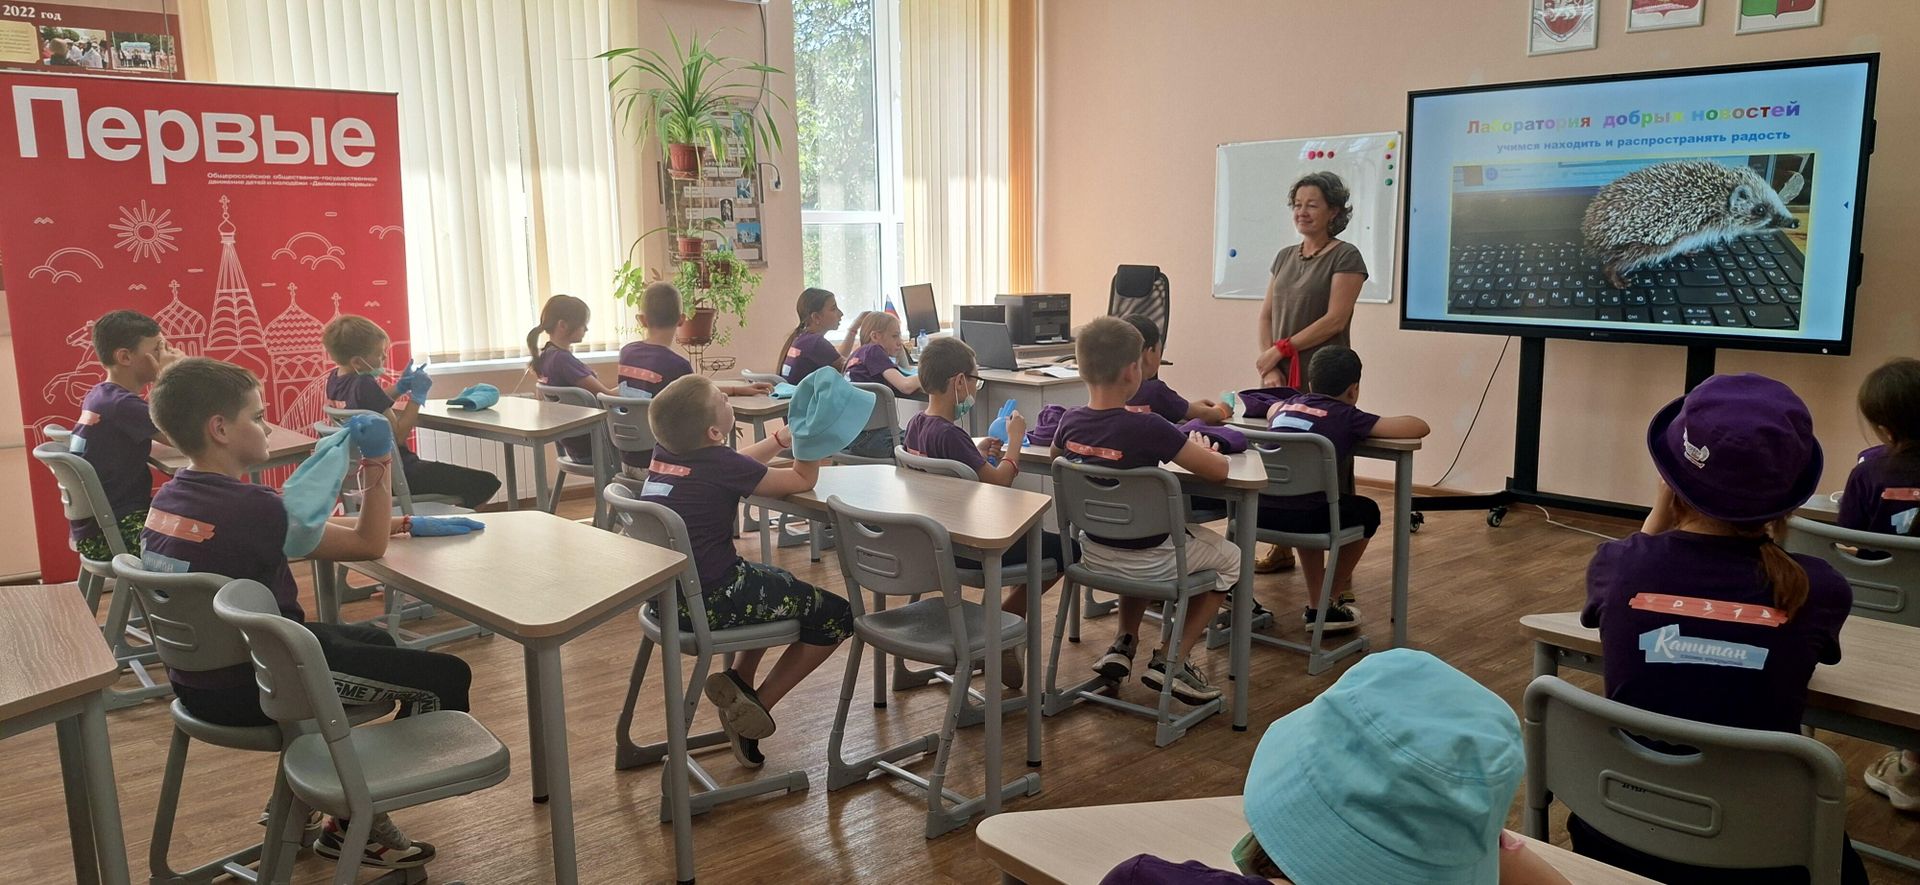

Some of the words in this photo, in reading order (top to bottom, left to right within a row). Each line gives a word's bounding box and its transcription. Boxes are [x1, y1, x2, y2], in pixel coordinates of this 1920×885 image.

[2, 4, 36, 18] 2022
[41, 11, 62, 21] год
[1467, 116, 1591, 134] Лаборатория
[1603, 109, 1685, 128] добрых
[1691, 100, 1800, 122] новостей
[11, 84, 376, 185] Первые
[1497, 143, 1540, 153] учимся
[1544, 138, 1601, 151] находить
[1605, 139, 1613, 147] и
[1617, 134, 1727, 148] распространять
[1731, 131, 1791, 144] радость
[207, 172, 271, 180] Общероссийское
[272, 173, 378, 182] общественно-государственное
[1654, 627, 1748, 659] Капитан
